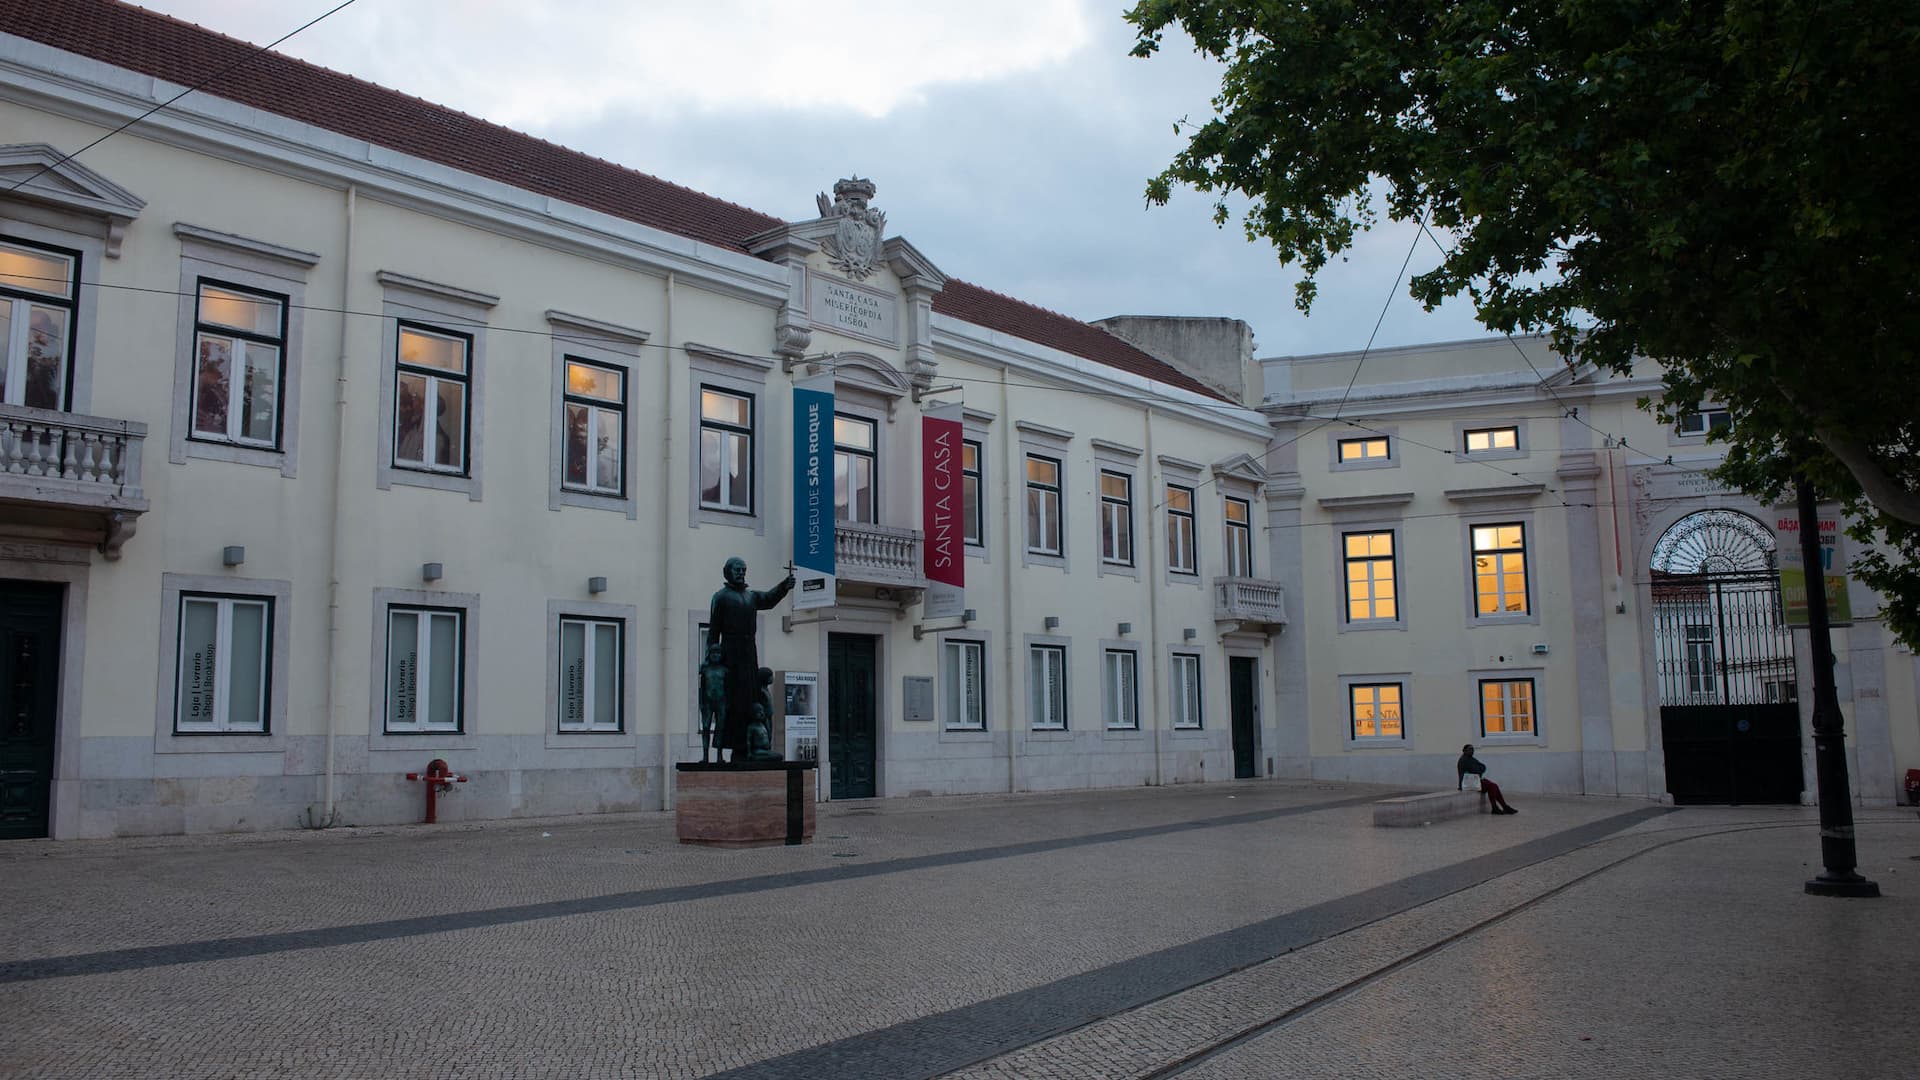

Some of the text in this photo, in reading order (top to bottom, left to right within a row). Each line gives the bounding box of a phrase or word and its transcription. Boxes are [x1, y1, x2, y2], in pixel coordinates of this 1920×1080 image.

[827, 286, 879, 308] SANTA CASA
[824, 298, 882, 321] MISERICORDIA
[839, 314, 868, 328] LISBOA
[806, 403, 821, 555] MUSEU DE SÃO ROQUE
[934, 431, 952, 567] SANTA CASA
[192, 652, 201, 689] Livraria
[191, 696, 201, 717] Loja
[398, 700, 406, 718] Loja
[1366, 710, 1399, 720] SNTA
